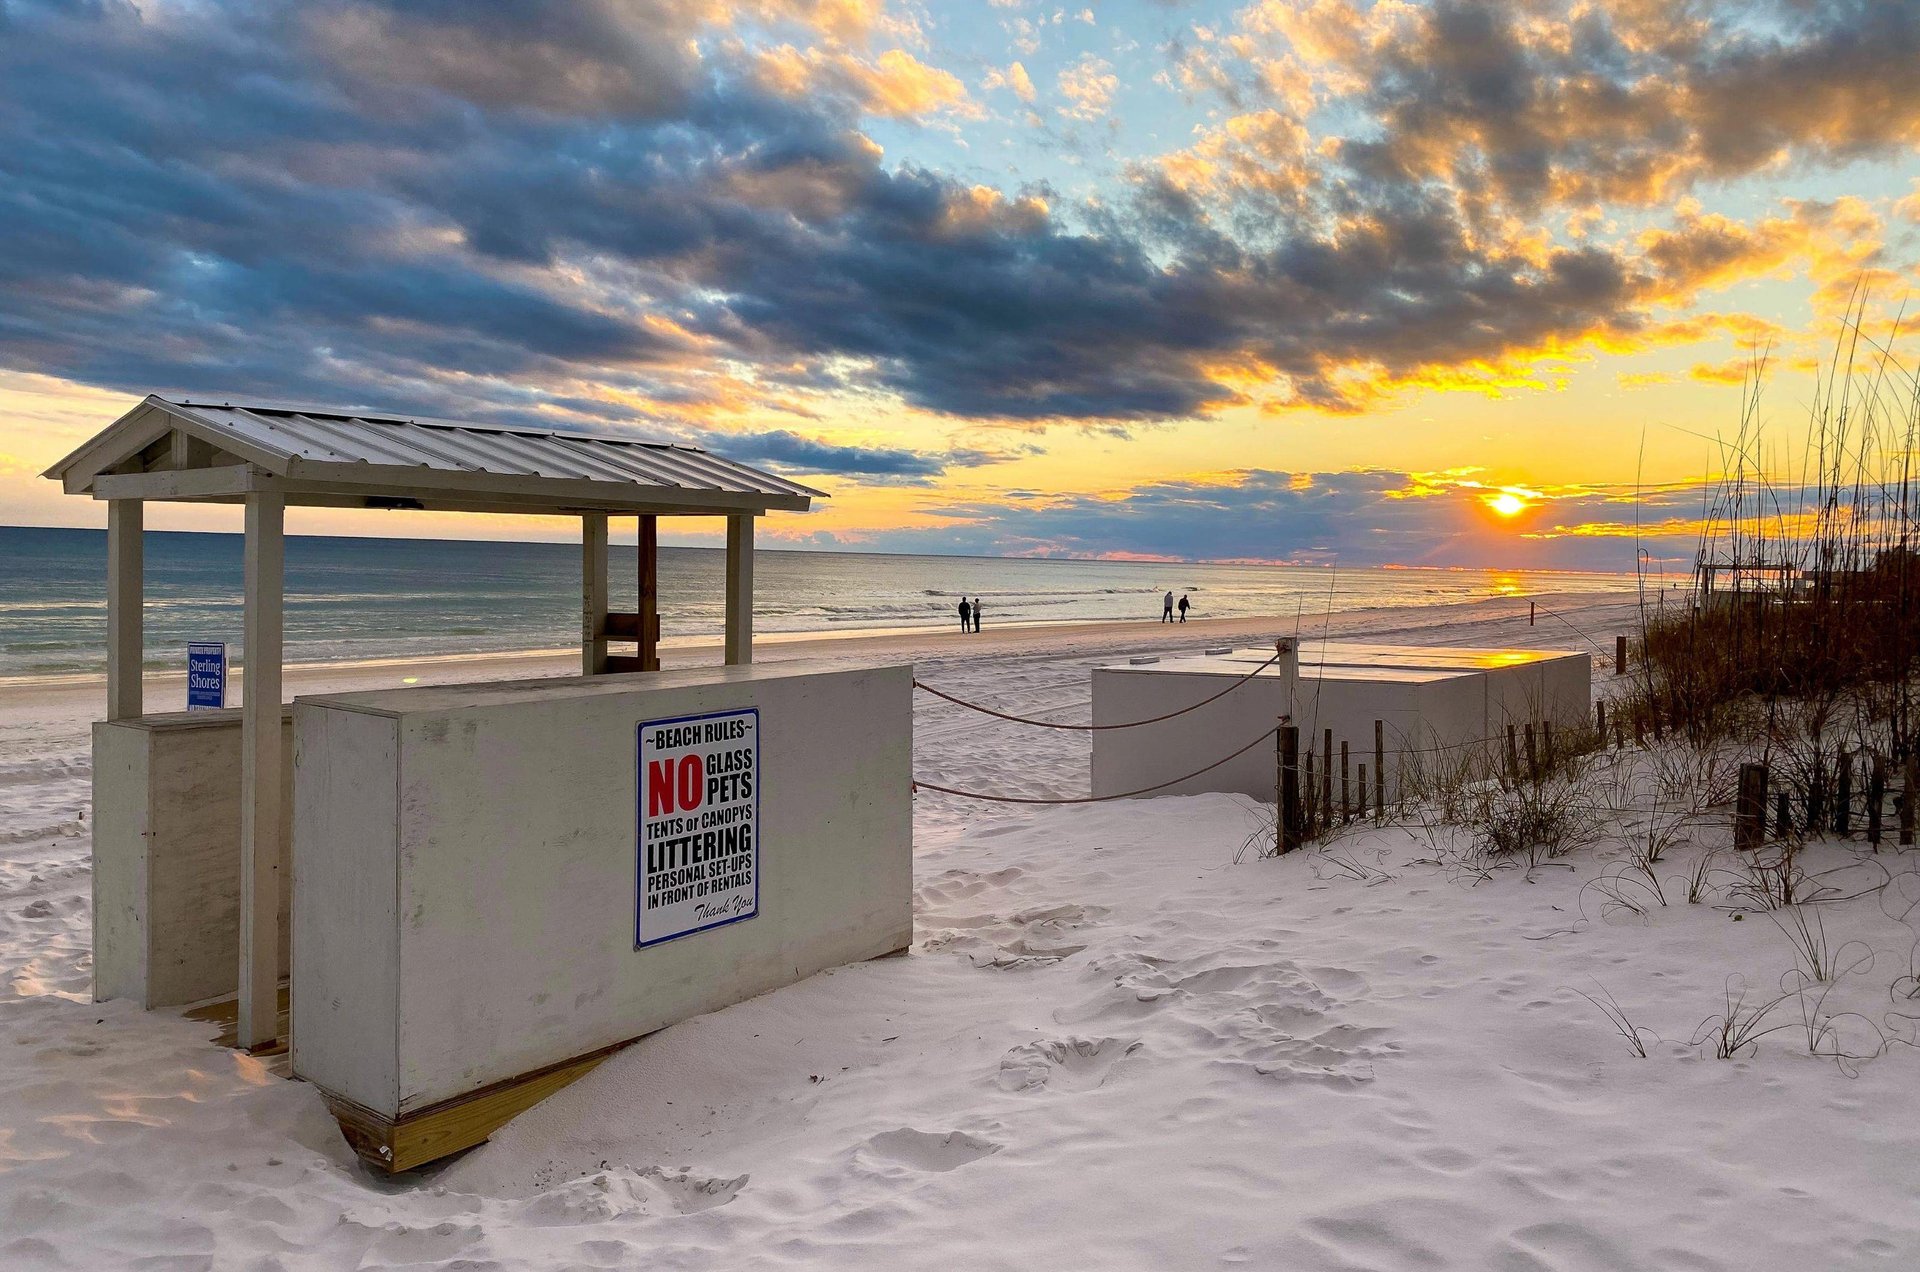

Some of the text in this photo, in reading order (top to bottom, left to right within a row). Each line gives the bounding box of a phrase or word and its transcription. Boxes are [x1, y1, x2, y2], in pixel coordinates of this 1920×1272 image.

[190, 659, 220, 676] Sterling
[190, 674, 220, 689] Shores
[649, 754, 703, 817] NO
[646, 803, 752, 840] TENTS or CANOPYS
[647, 823, 751, 874] LITTERING
[647, 853, 752, 893] PERSONAL SET-UPS
[647, 870, 752, 910] IN FRONT OF RENTALS
[694, 894, 754, 921] Thank You
